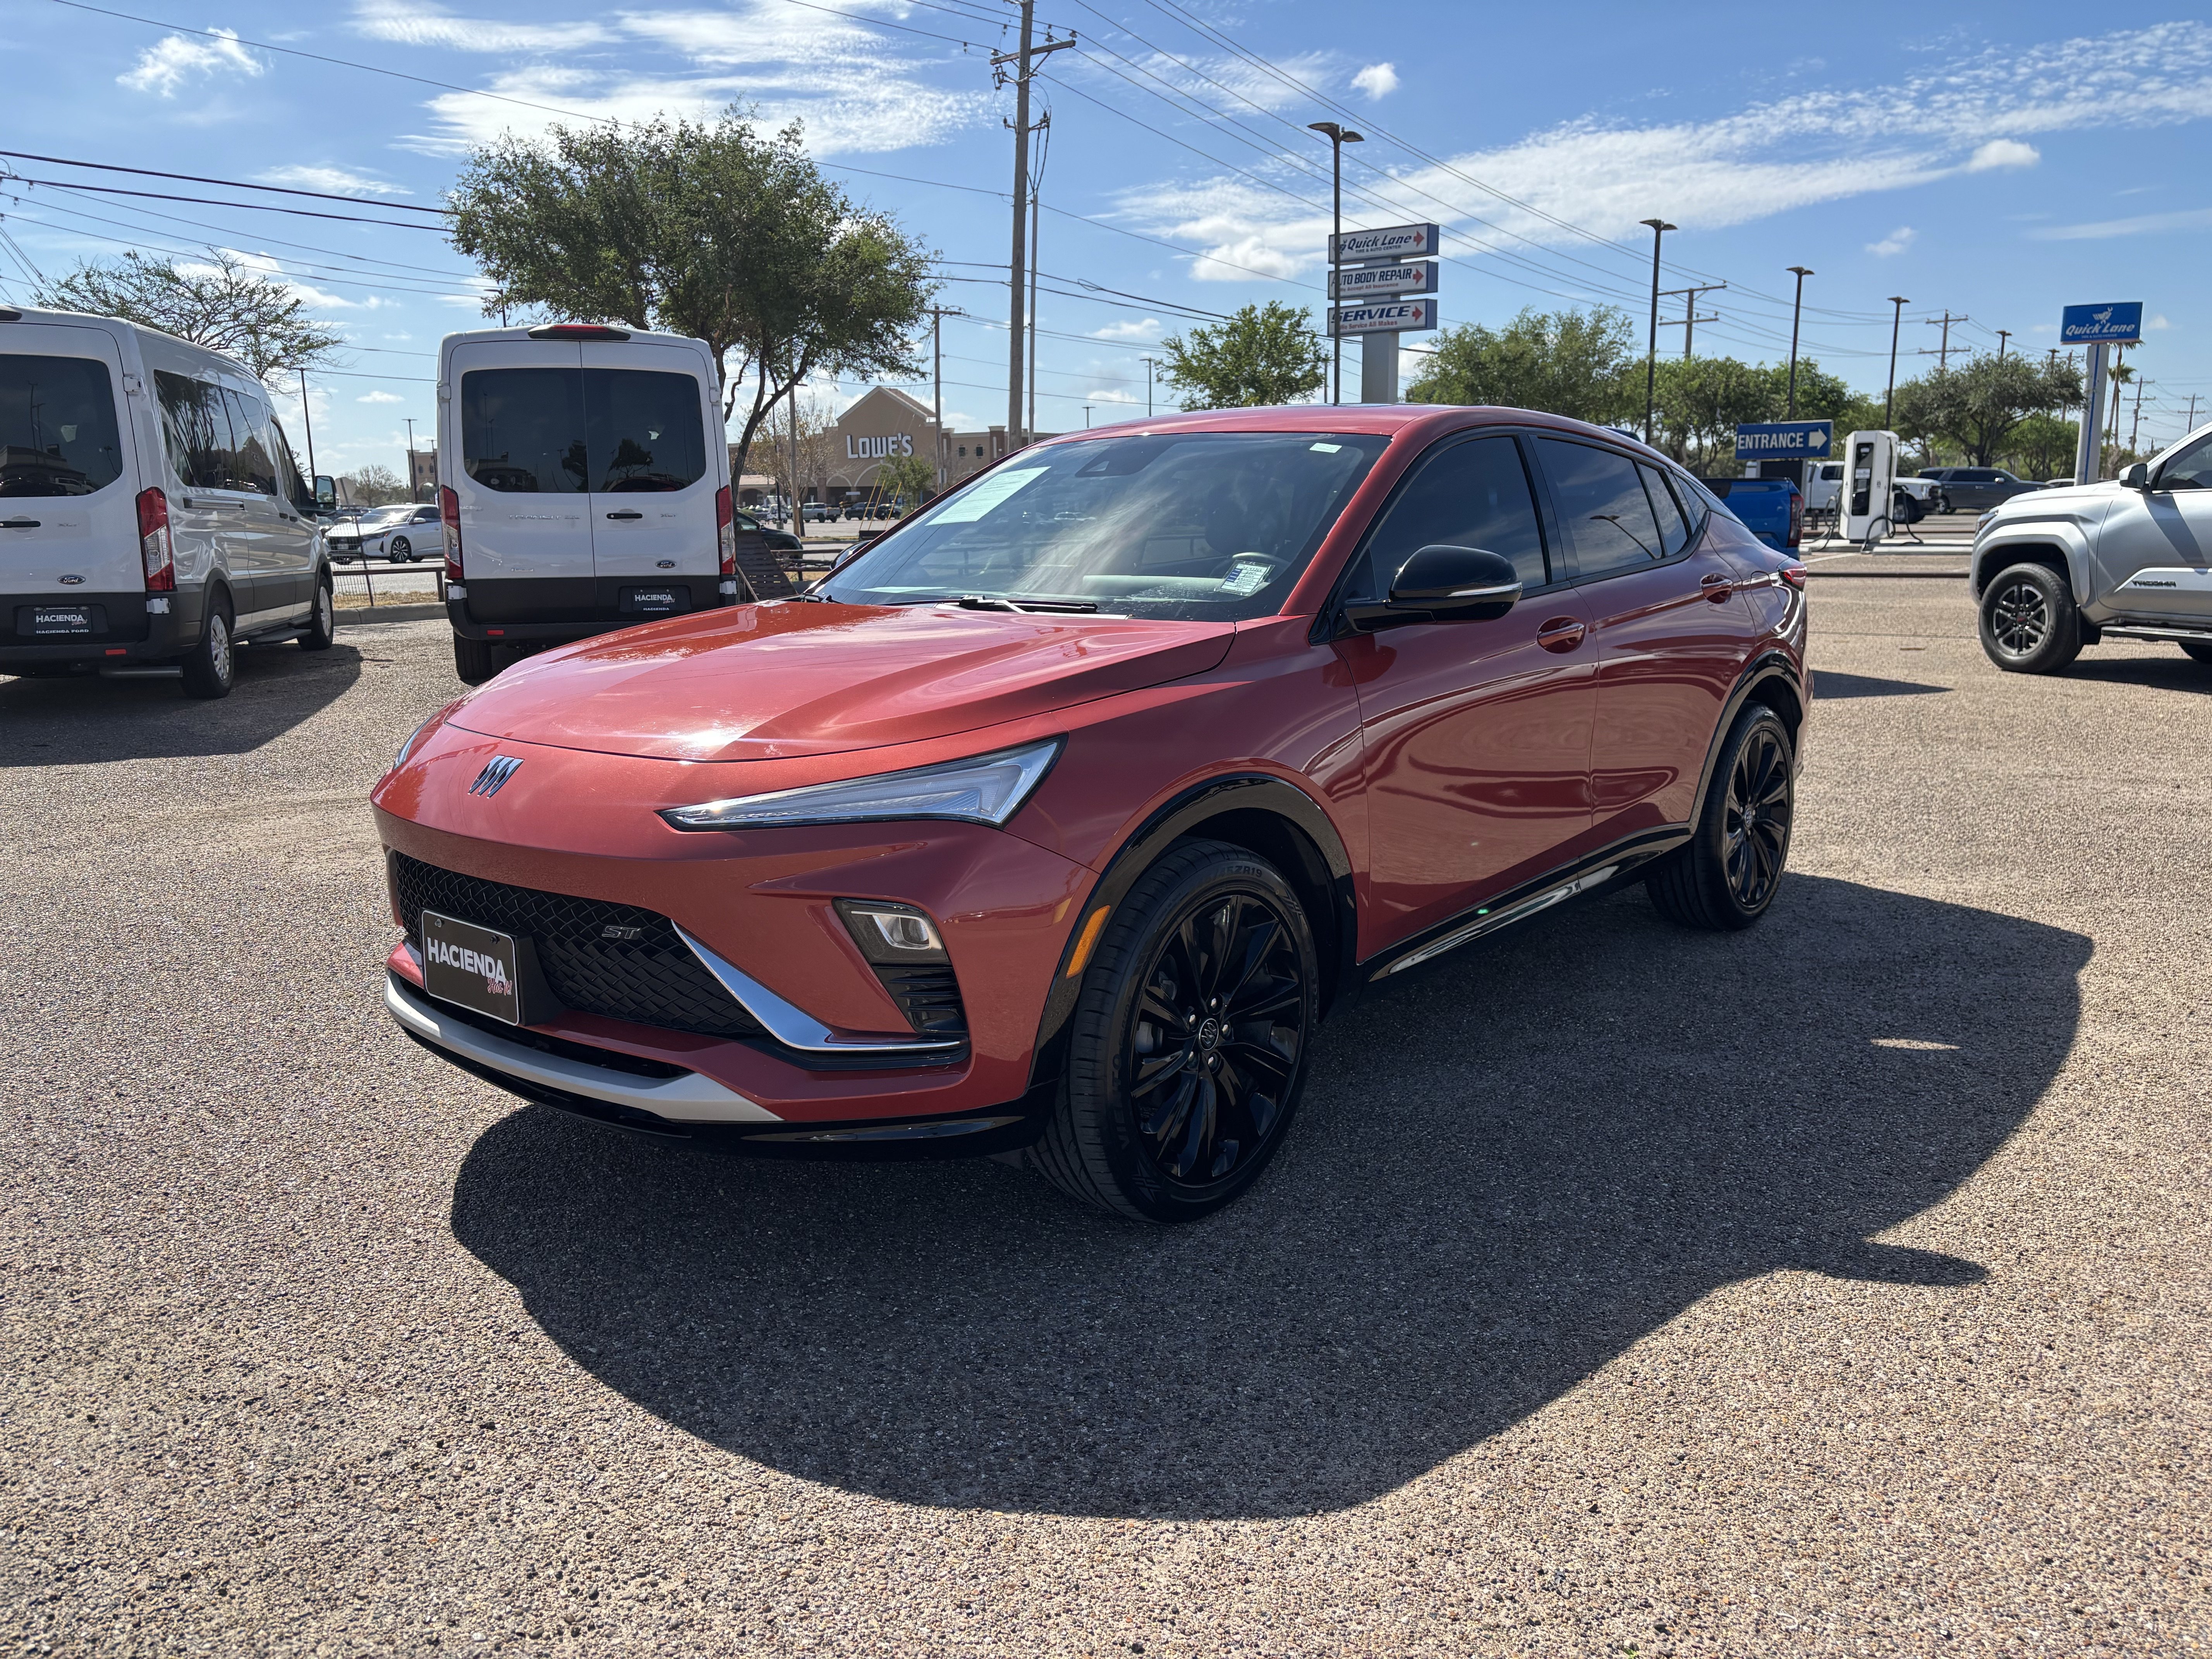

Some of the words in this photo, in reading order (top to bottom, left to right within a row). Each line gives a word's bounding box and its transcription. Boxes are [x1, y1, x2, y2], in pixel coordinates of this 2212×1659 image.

[1348, 236, 1379, 250] Quick
[1381, 235, 1412, 246] Lane
[1354, 271, 1378, 283] BODY
[1379, 268, 1412, 282] REPAIR
[1331, 306, 1411, 323] SERVICE
[2066, 323, 2102, 336] Quick
[2102, 322, 2135, 333] Lane
[847, 433, 913, 459] LOWE'S
[1738, 432, 1804, 450] ENTRANCE
[36, 614, 84, 623] HACIENDA
[601, 926, 641, 939] ST
[427, 937, 506, 986] HACIENDA
